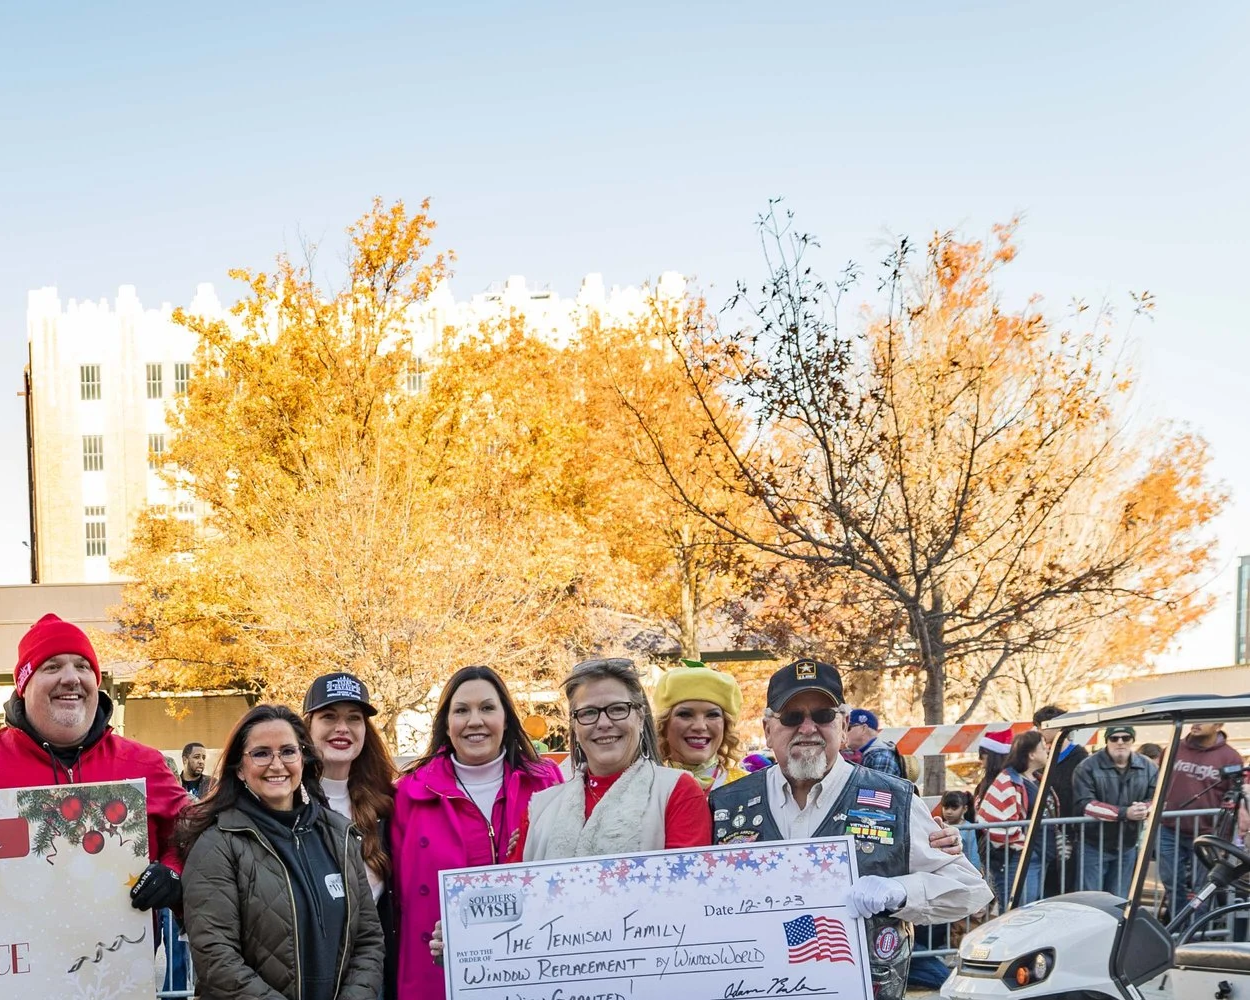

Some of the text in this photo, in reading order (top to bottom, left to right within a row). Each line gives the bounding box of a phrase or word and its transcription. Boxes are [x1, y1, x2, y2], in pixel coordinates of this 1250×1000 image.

[468, 893, 518, 905] SOLDIER'S
[739, 895, 805, 914] 12-9-23
[704, 904, 734, 917] Date
[456, 948, 494, 958] PAY TO THE
[458, 956, 482, 964] ORDER
